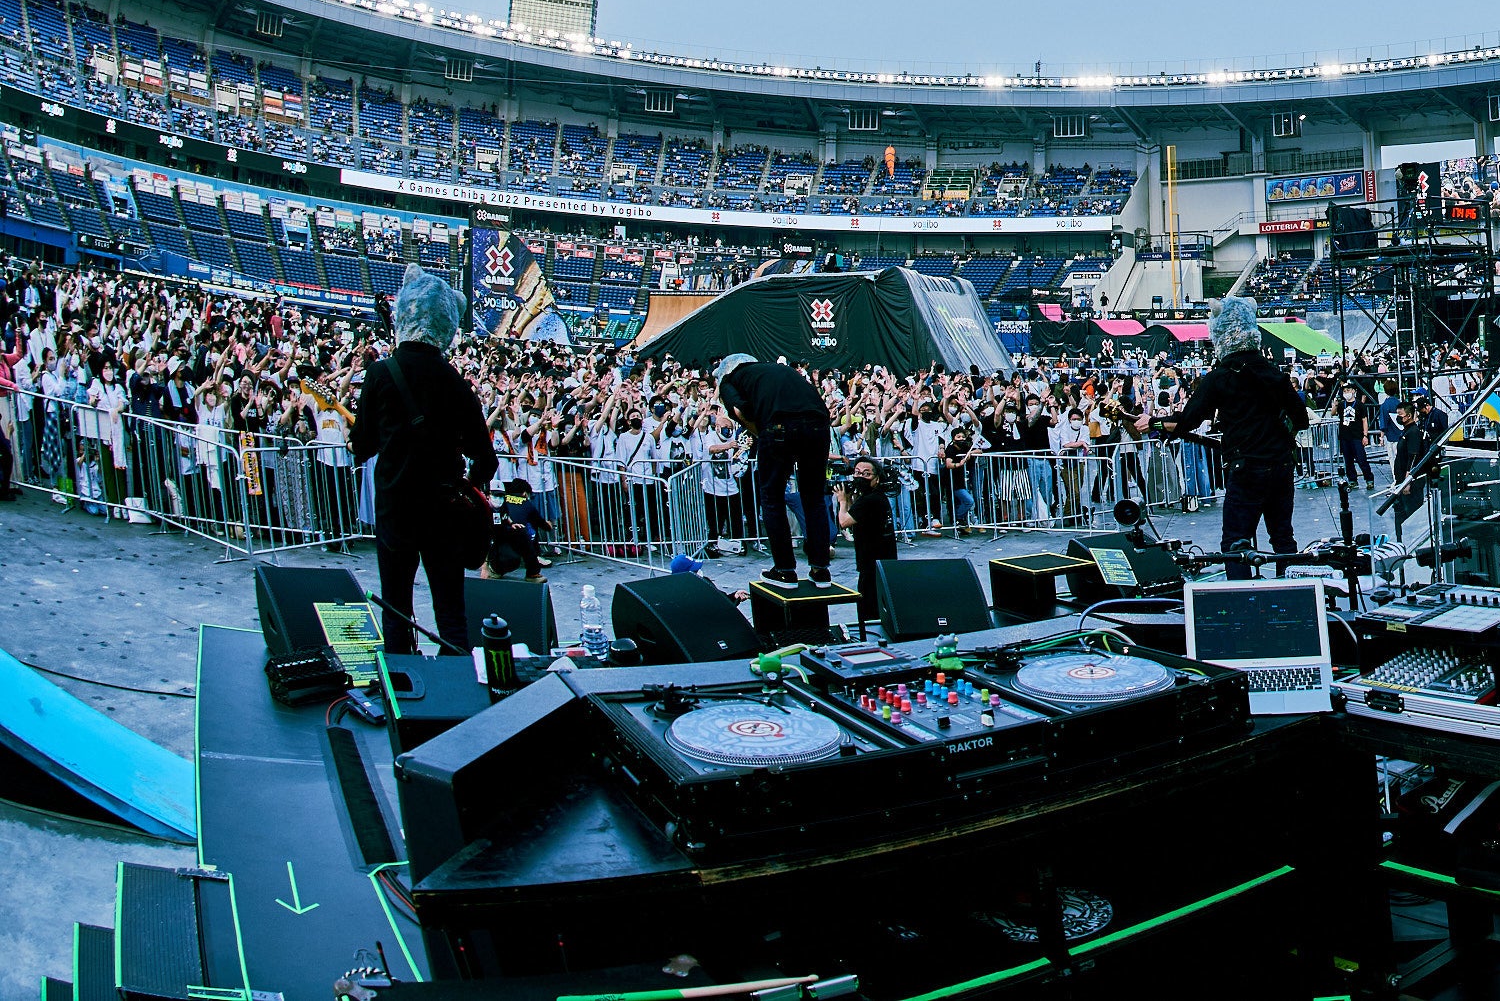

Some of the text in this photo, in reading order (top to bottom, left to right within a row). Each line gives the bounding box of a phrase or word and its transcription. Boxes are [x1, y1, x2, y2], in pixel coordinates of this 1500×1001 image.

[398, 180, 652, 218] X Games Chiba 2022 Presented by Yogibo
[487, 212, 509, 223] GAMES
[1261, 223, 1299, 232] LOTTERIA
[485, 275, 515, 286] GAMES
[484, 296, 517, 312] yogibo
[811, 321, 835, 329] GAMES
[811, 337, 837, 349] yogibo
[944, 737, 993, 754] RAKTOR
[1421, 779, 1466, 814] Pearl
